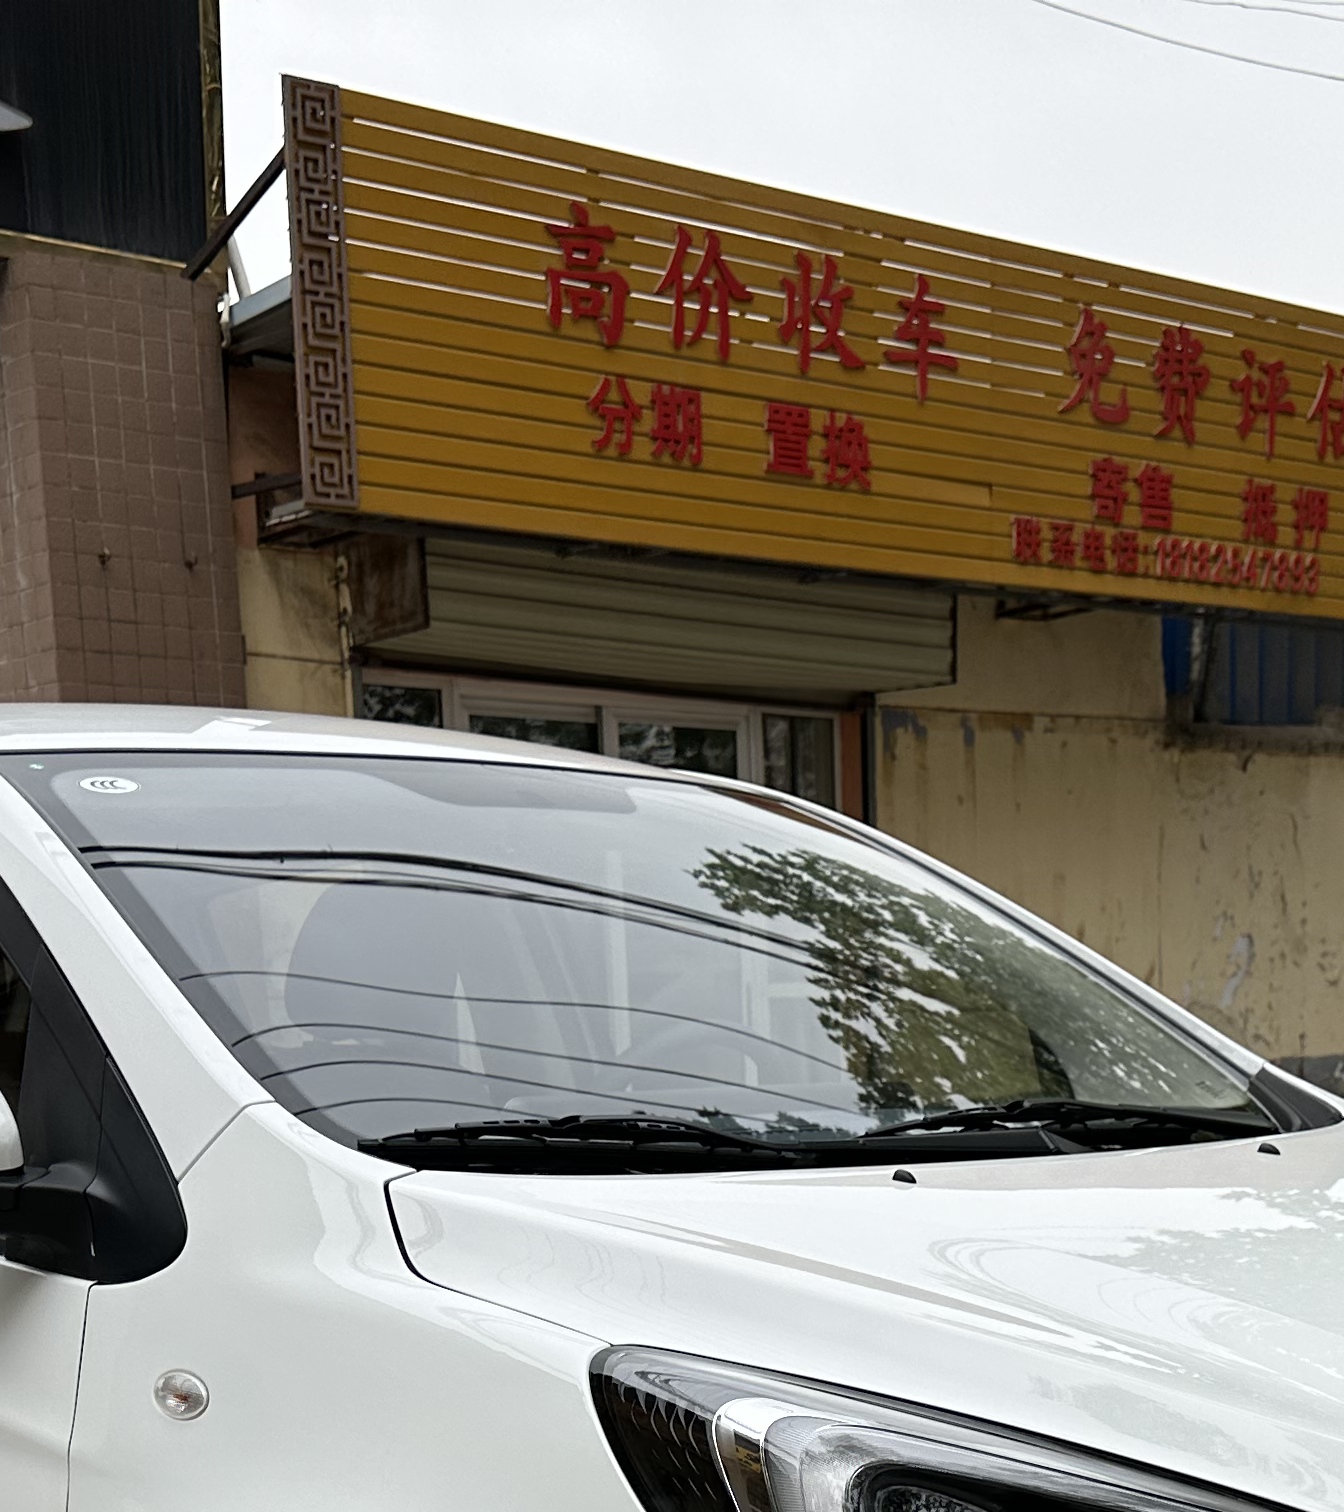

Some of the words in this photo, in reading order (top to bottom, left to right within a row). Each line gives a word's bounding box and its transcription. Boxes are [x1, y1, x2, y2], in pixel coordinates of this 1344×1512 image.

[545, 200, 959, 405] 高价收车
[586, 374, 703, 467] 分期
[763, 401, 872, 491] 置换
[1089, 456, 1174, 531] 寄售
[1241, 478, 1329, 549] 抵押
